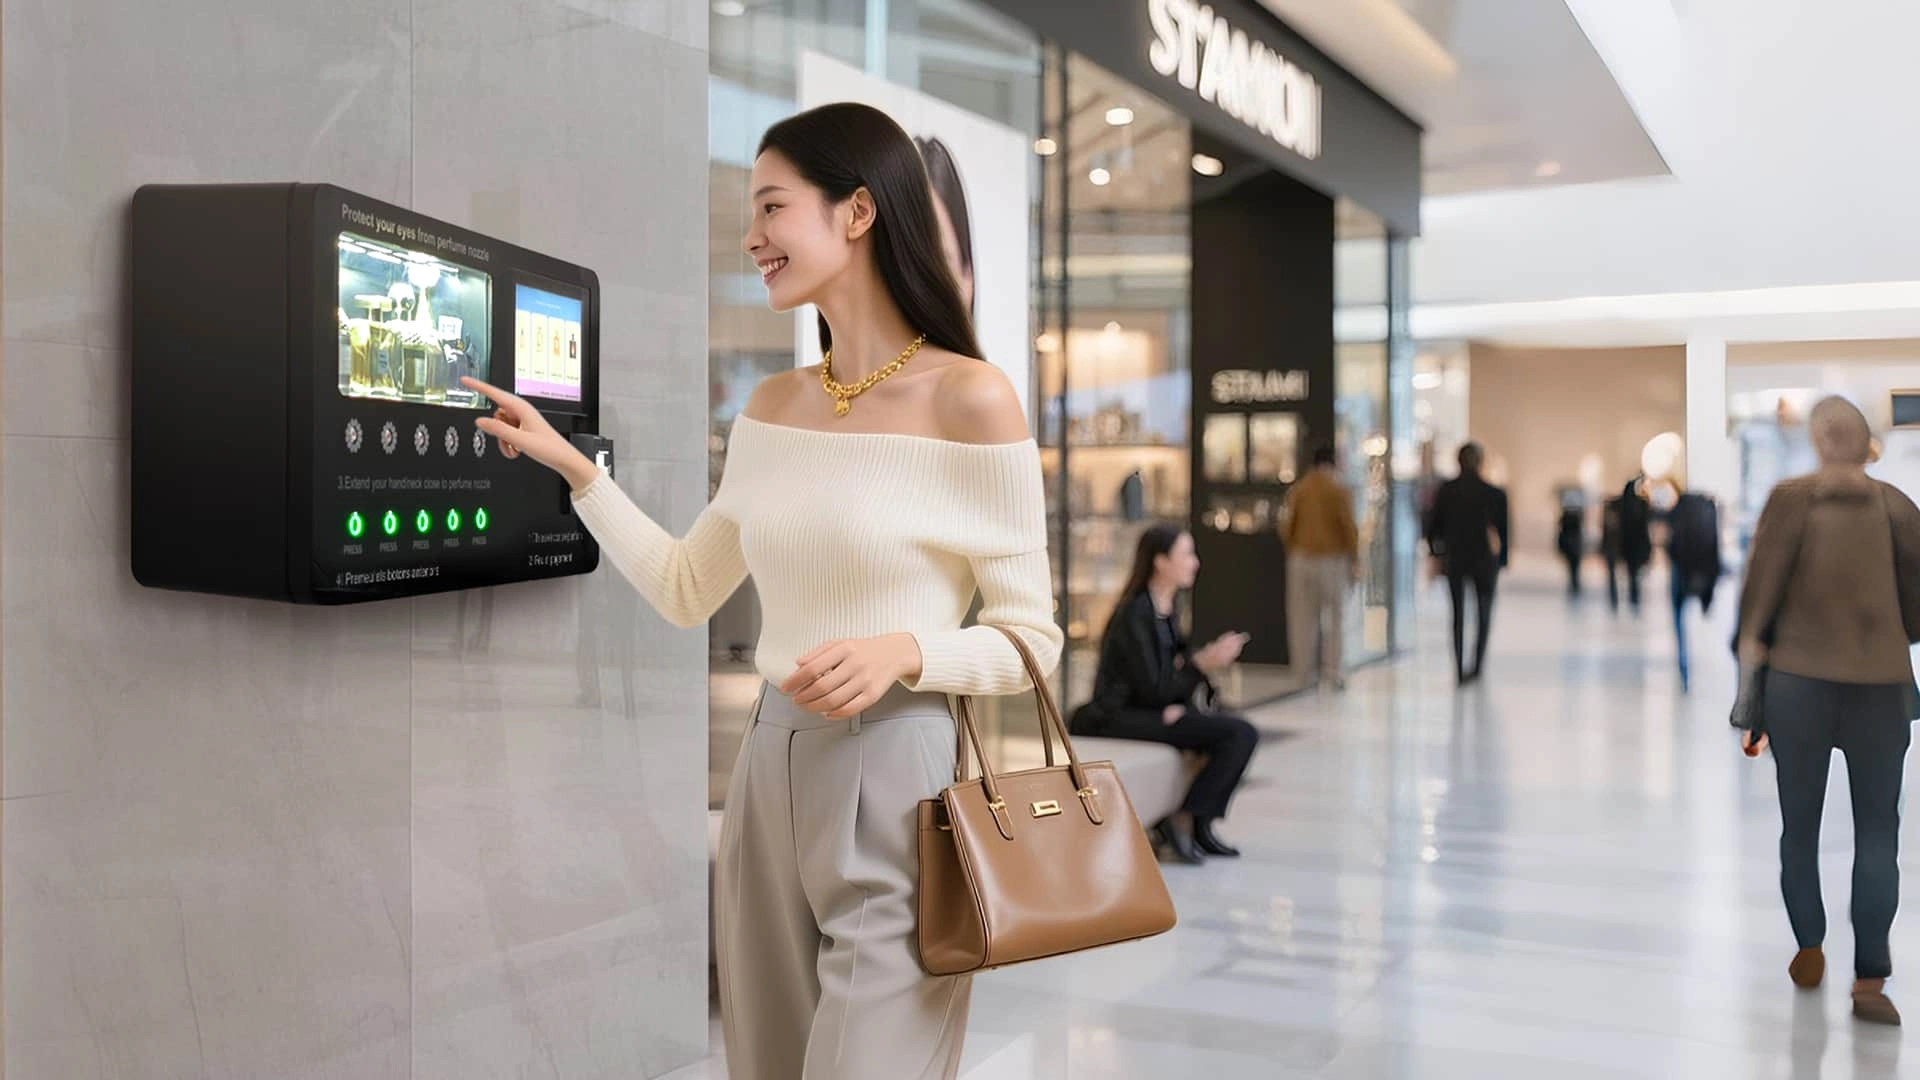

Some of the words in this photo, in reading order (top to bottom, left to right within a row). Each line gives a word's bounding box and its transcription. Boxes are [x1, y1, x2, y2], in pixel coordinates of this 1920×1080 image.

[341, 203, 375, 227] Protect
[375, 218, 396, 233] your
[396, 224, 416, 240] eyes
[417, 226, 436, 247] from
[436, 235, 467, 255] perfume
